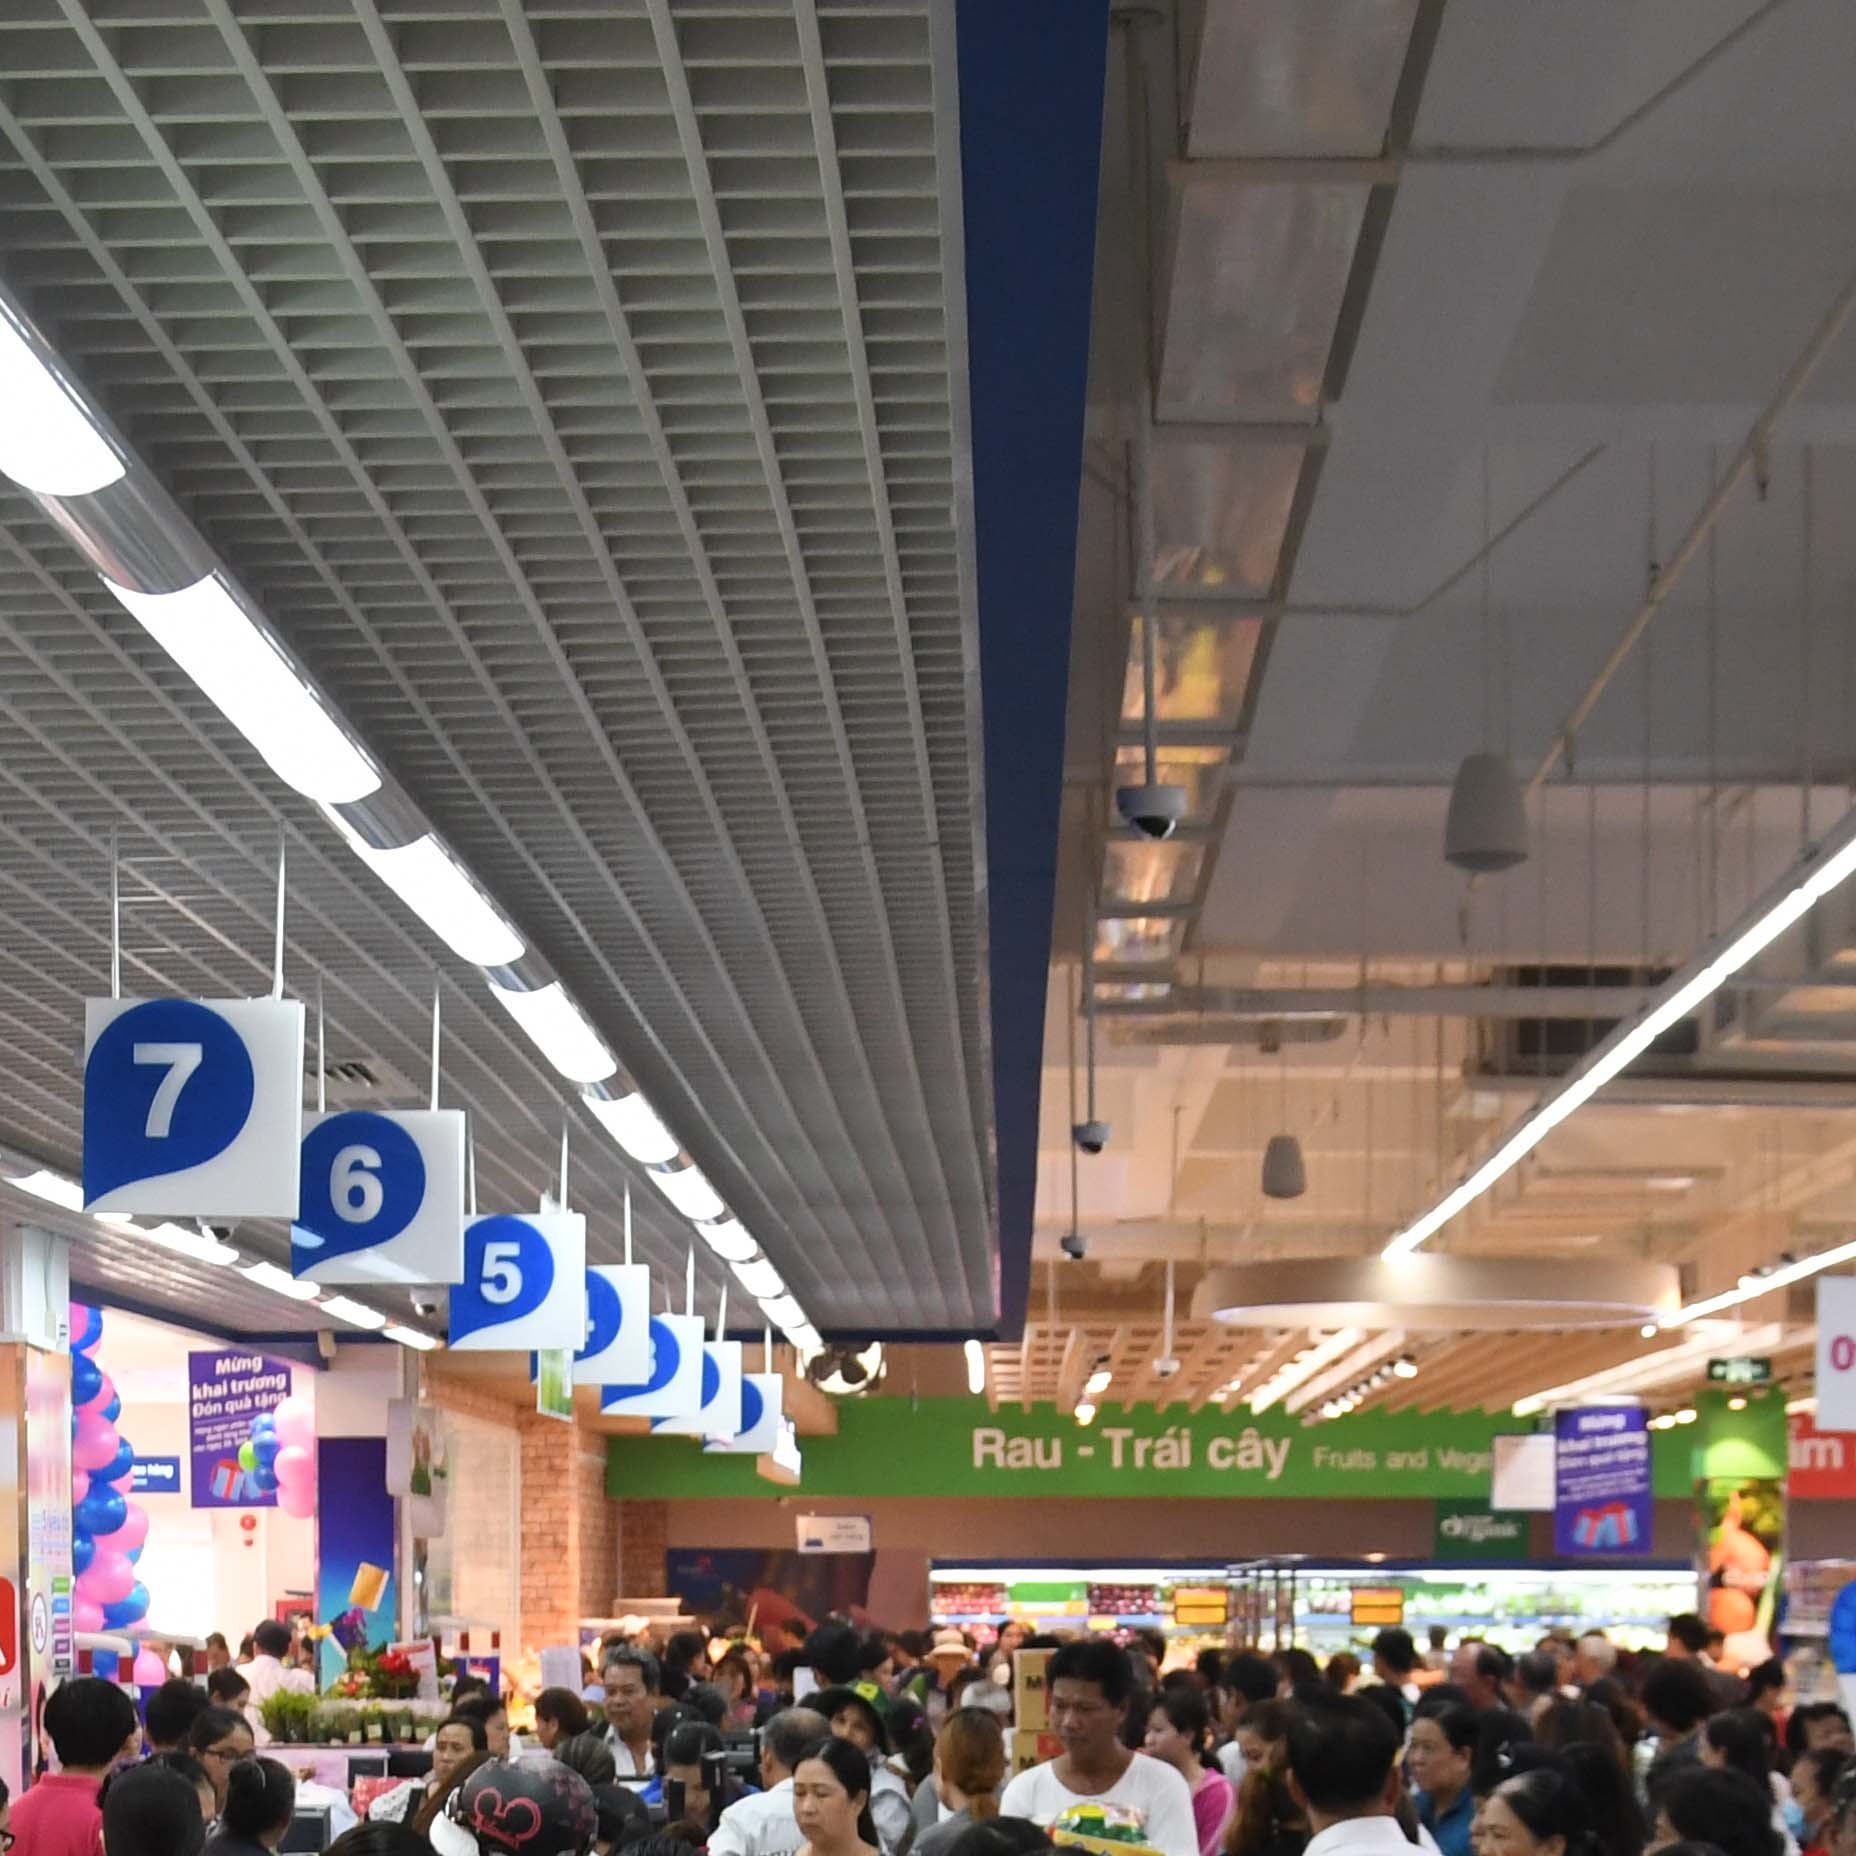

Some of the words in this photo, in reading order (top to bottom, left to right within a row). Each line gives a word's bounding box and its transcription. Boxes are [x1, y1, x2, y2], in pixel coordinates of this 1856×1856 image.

[132, 1043, 204, 1139] 7
[328, 1144, 385, 1224] 6
[479, 1241, 523, 1304] 5
[973, 1427, 1062, 1469] Rau
[1101, 1425, 1191, 1469] Trái
[1206, 1427, 1292, 1480] cây
[1385, 1447, 1428, 1471] and
